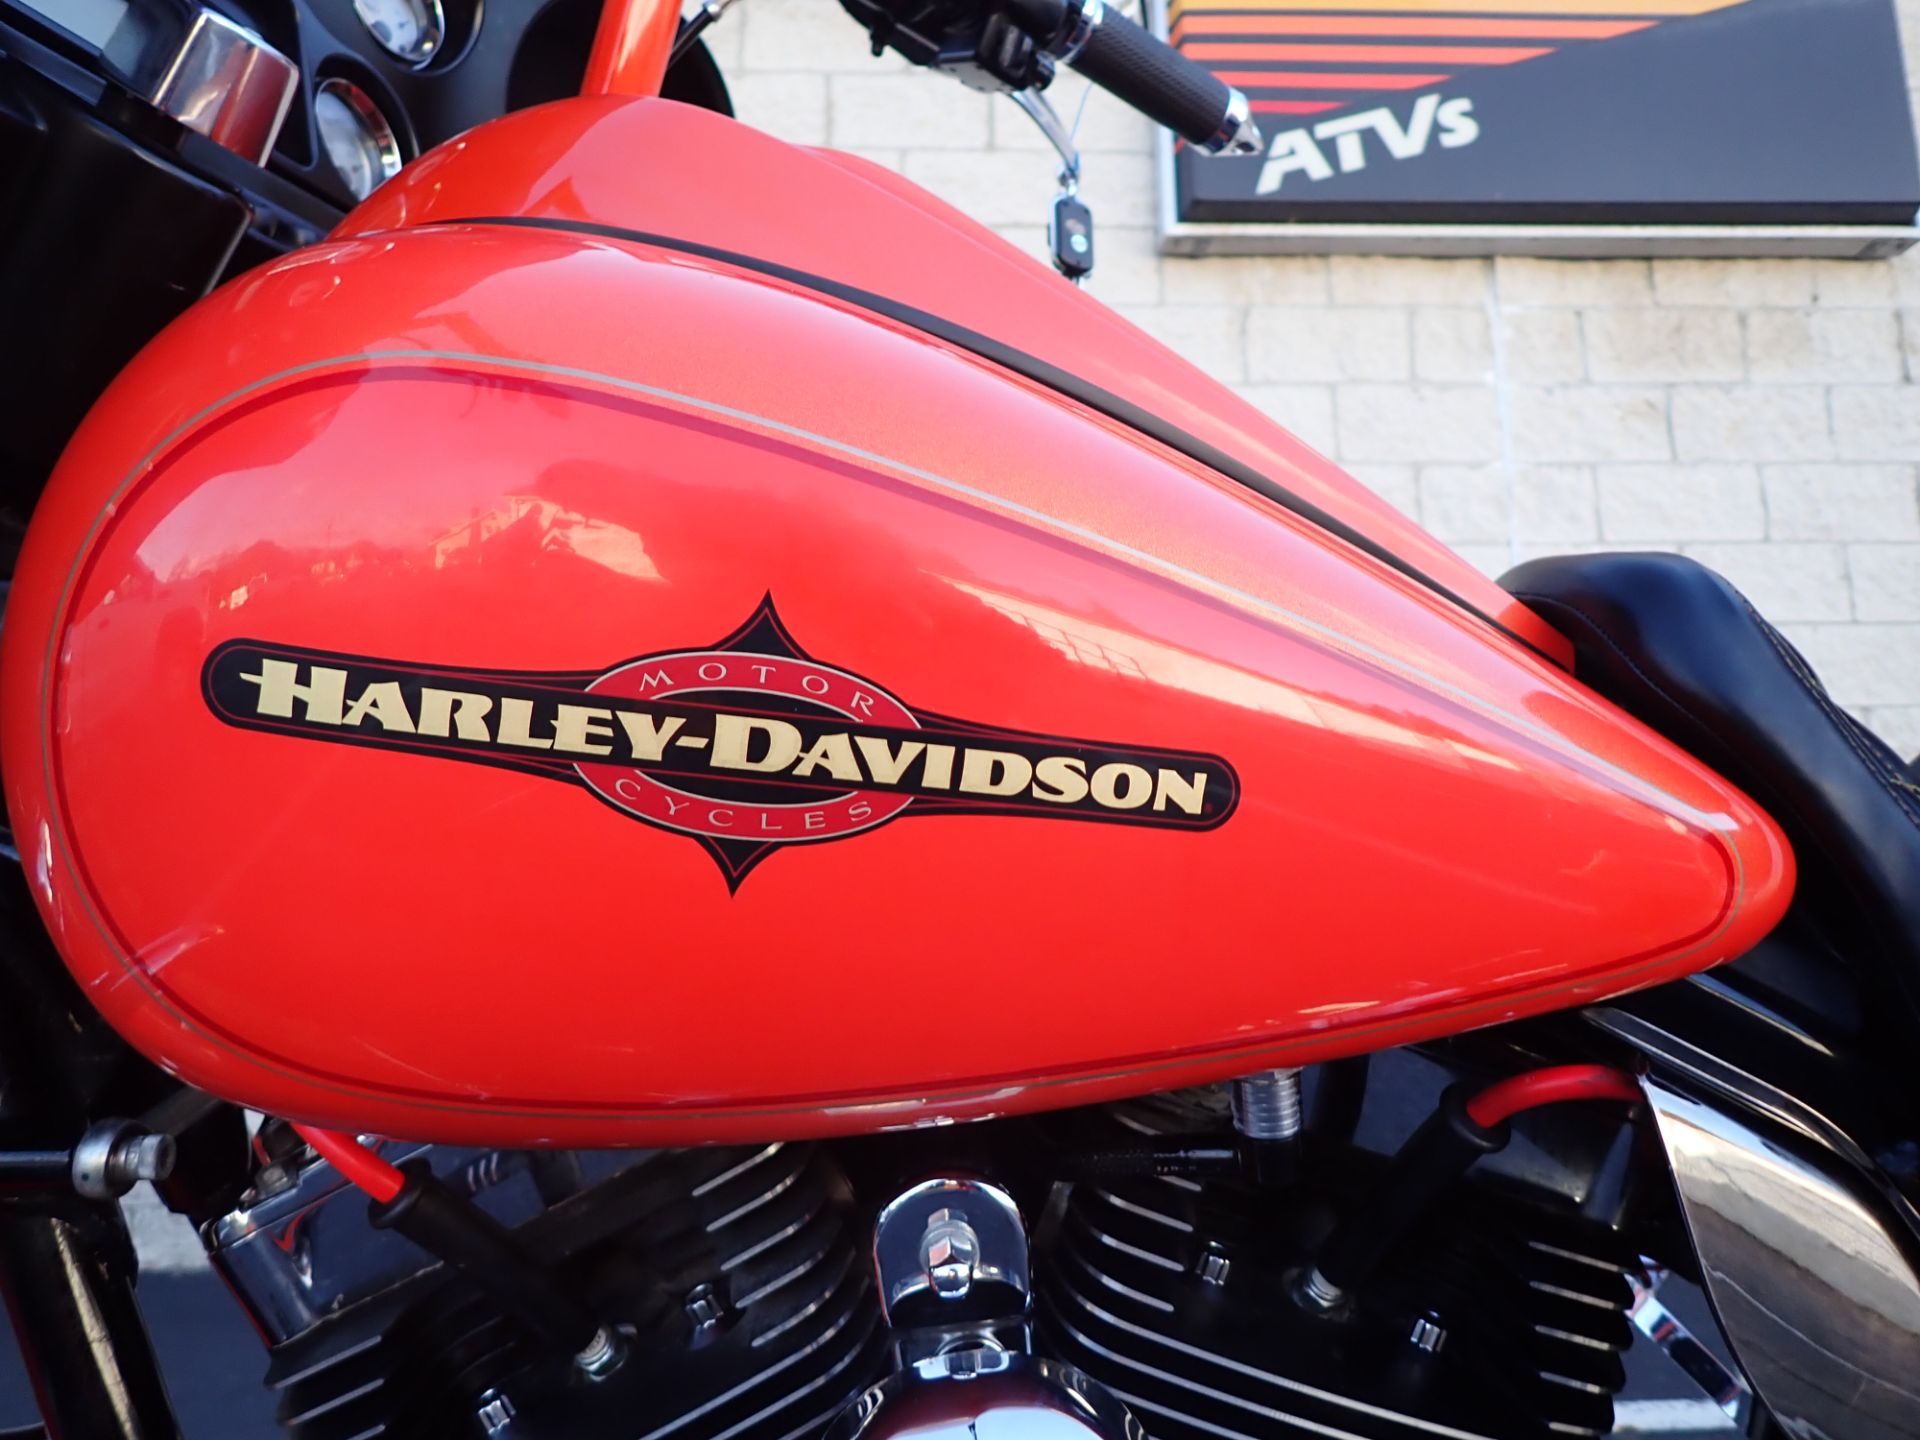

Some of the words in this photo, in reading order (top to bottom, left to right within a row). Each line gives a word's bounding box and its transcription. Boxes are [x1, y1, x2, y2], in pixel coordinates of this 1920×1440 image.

[640, 662, 875, 716] MOTOR
[239, 658, 1208, 815] HARLEY-DAVIDSON
[615, 778, 873, 830] CYCLES
